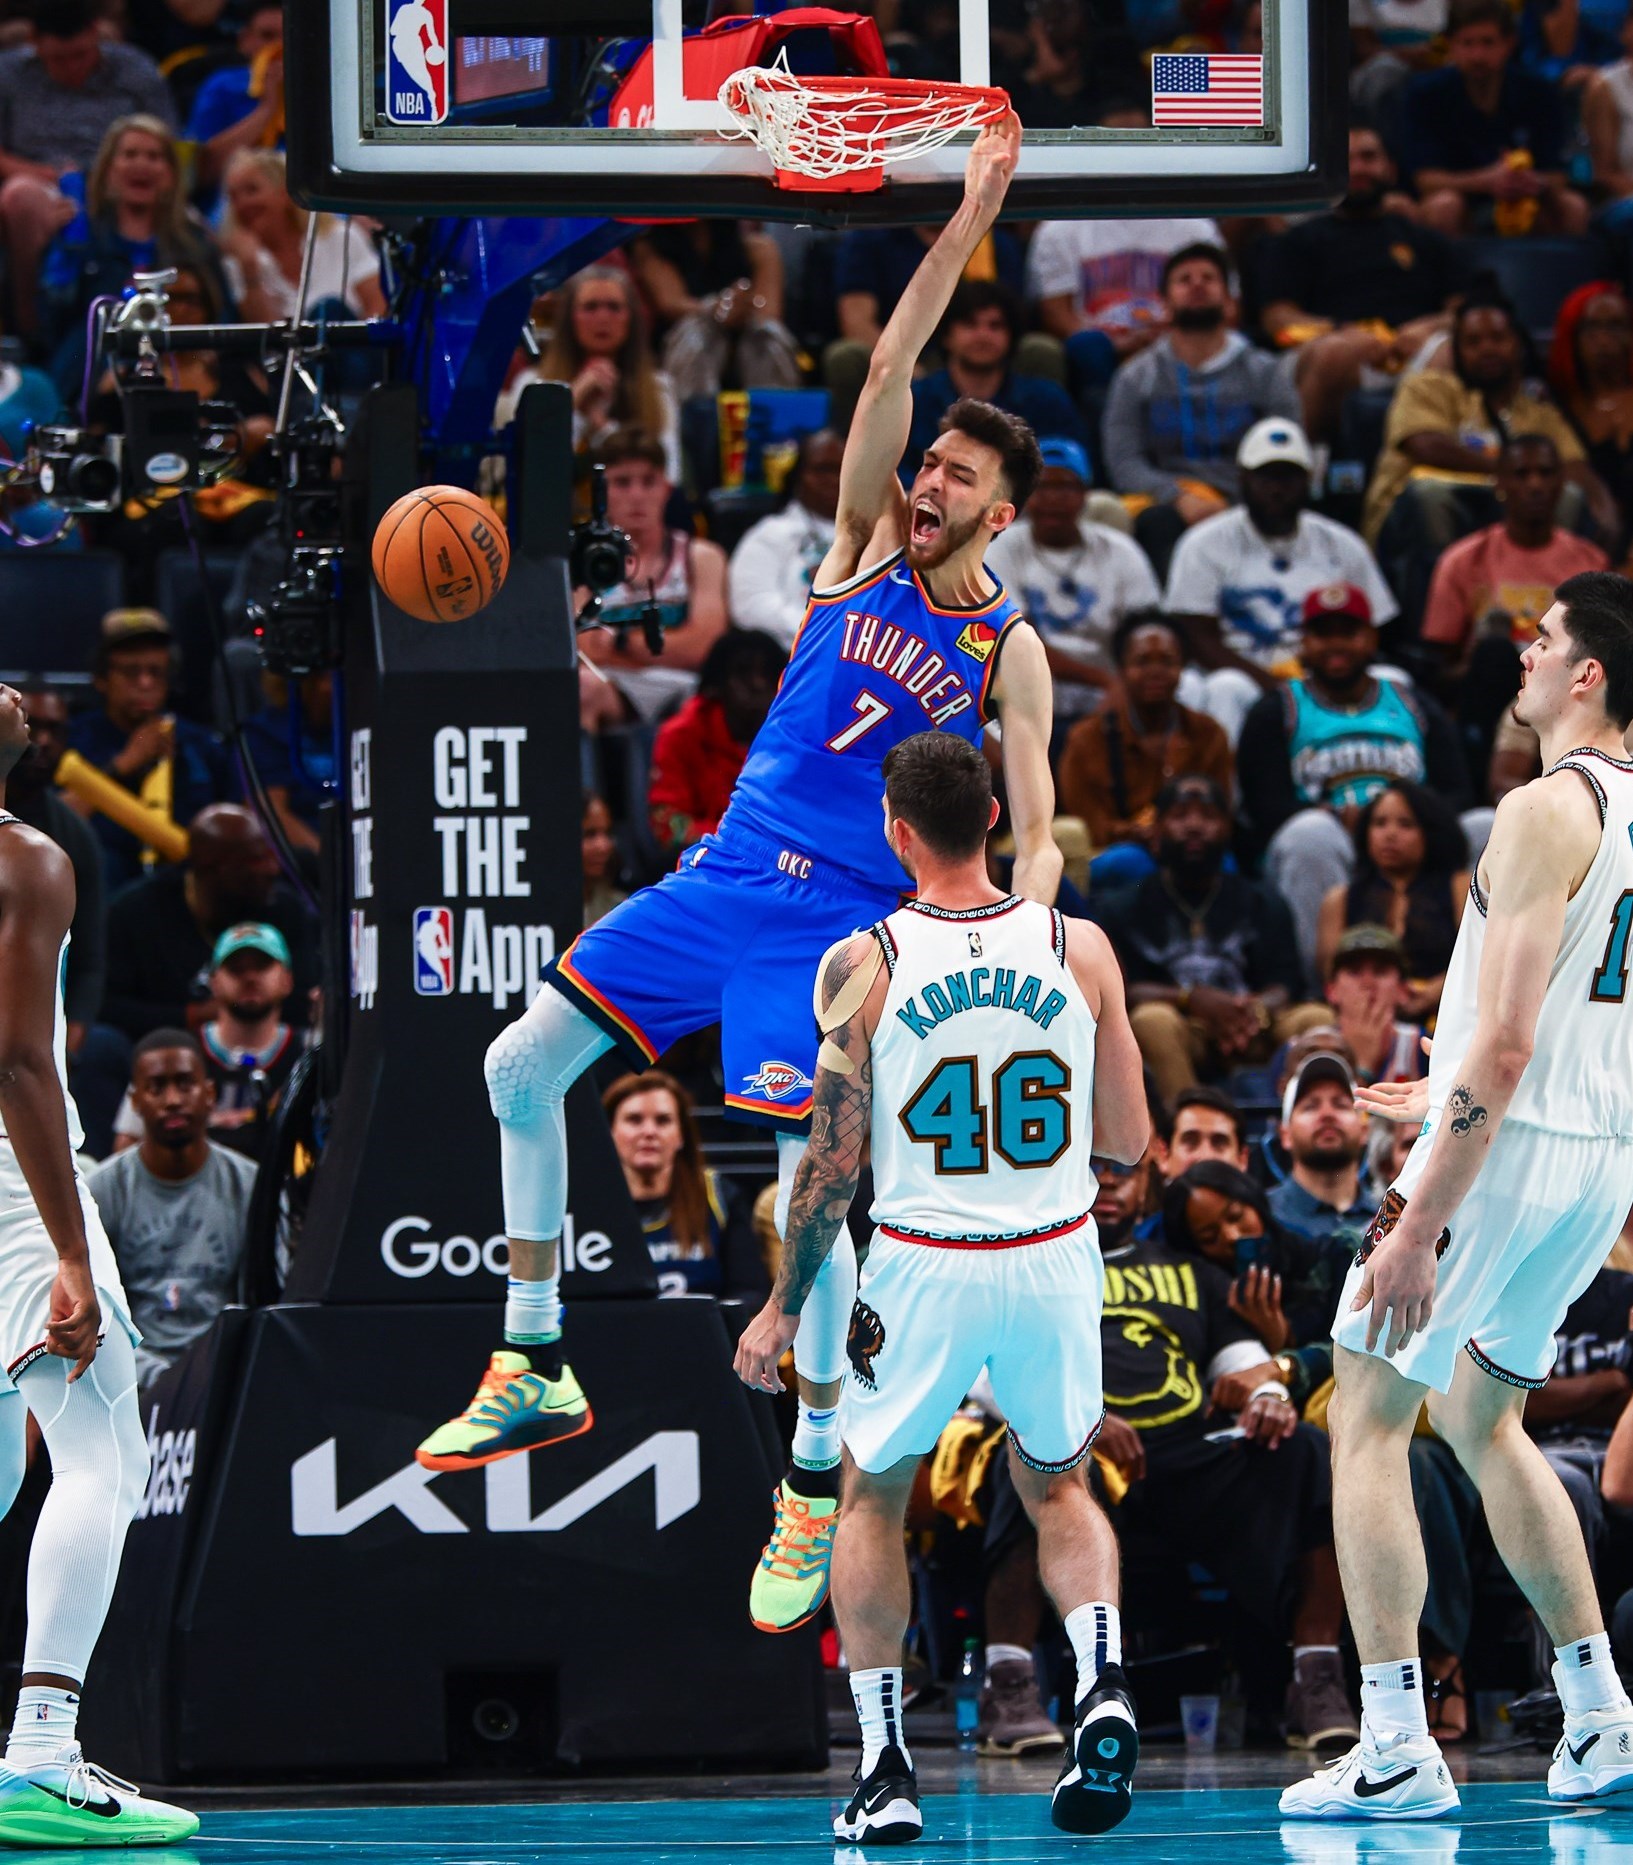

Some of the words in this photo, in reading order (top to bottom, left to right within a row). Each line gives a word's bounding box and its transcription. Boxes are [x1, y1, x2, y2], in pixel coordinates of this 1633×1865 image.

[396, 92, 425, 115] NBA
[840, 612, 975, 728] THUNDER
[958, 635, 986, 660] Love's
[825, 688, 893, 754] 7
[433, 725, 527, 809] GET
[433, 815, 531, 897] THE
[777, 850, 812, 880] OKC
[459, 907, 555, 1010] App
[896, 967, 1067, 1040] KONCHAR
[754, 1072, 794, 1087] OKC
[897, 1049, 1072, 1176] 46
[381, 1213, 613, 1279] Goole
[291, 1430, 700, 1536] KIA
